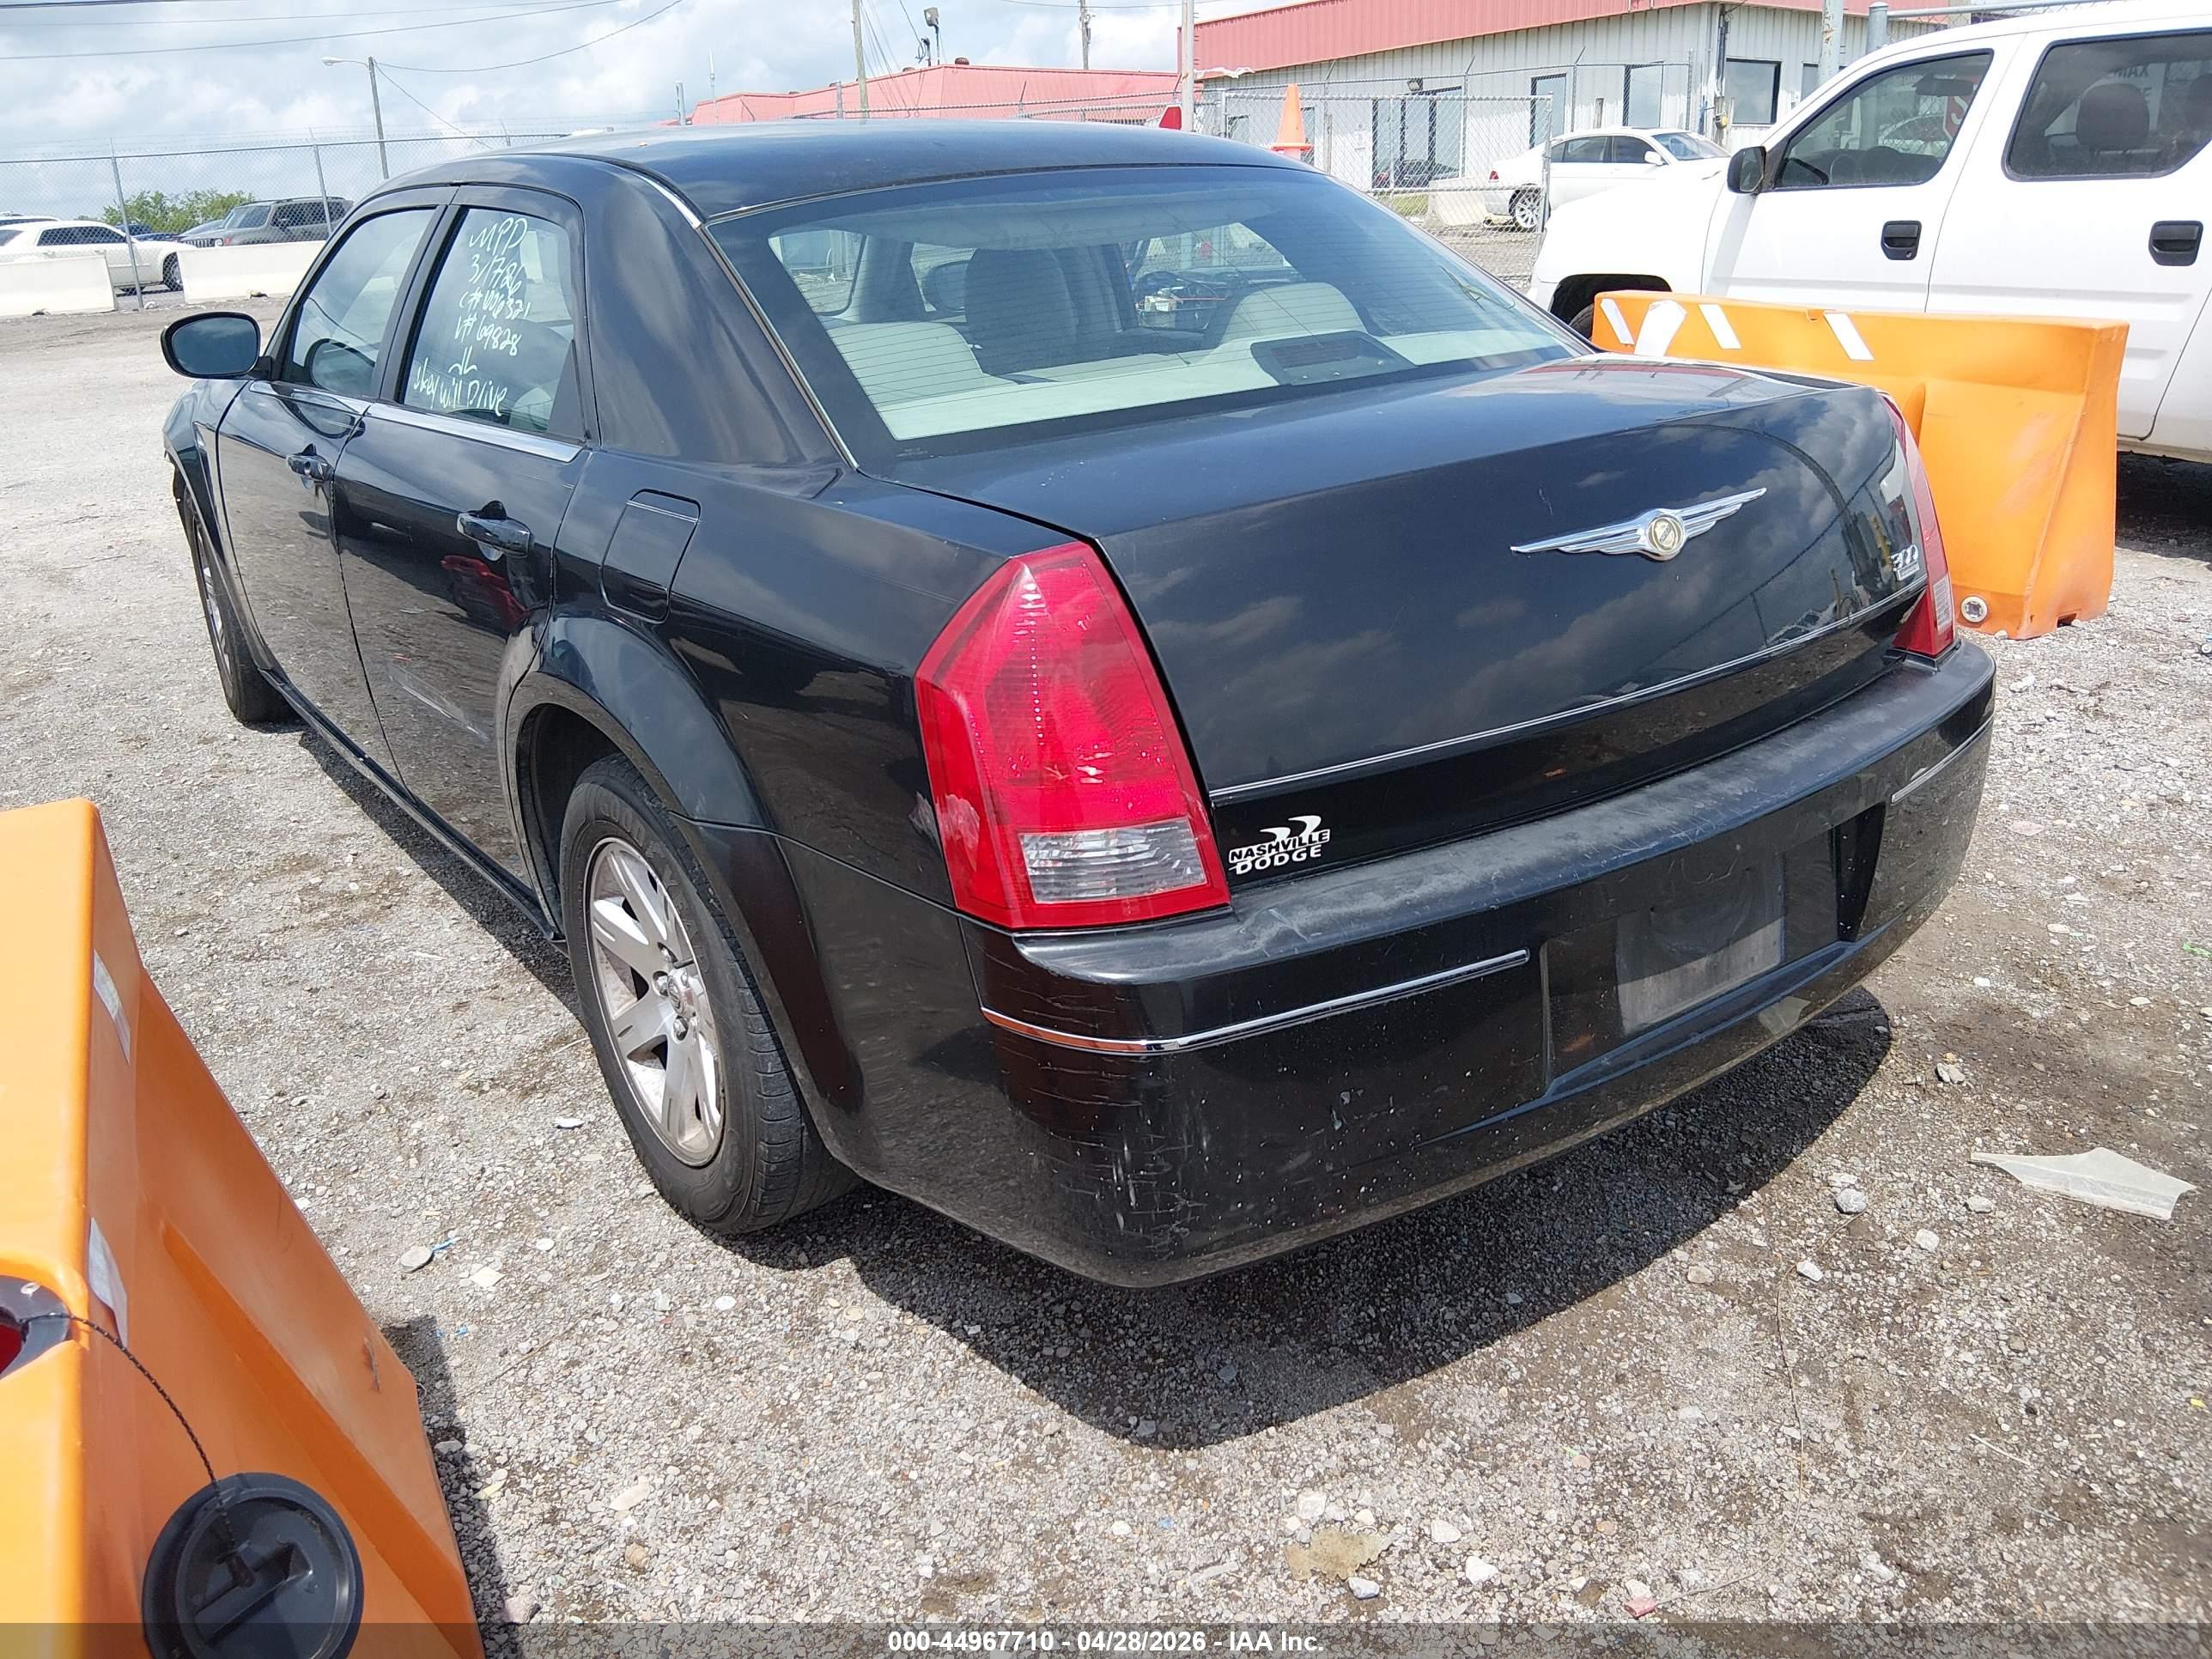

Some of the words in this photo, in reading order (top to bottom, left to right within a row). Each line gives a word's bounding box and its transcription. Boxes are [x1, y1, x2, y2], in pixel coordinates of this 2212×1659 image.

[468, 216, 529, 256] MPD
[1888, 544, 1919, 572] 300
[1230, 830, 1330, 862] NASHVILLE
[1235, 843, 1322, 875] DODGE
